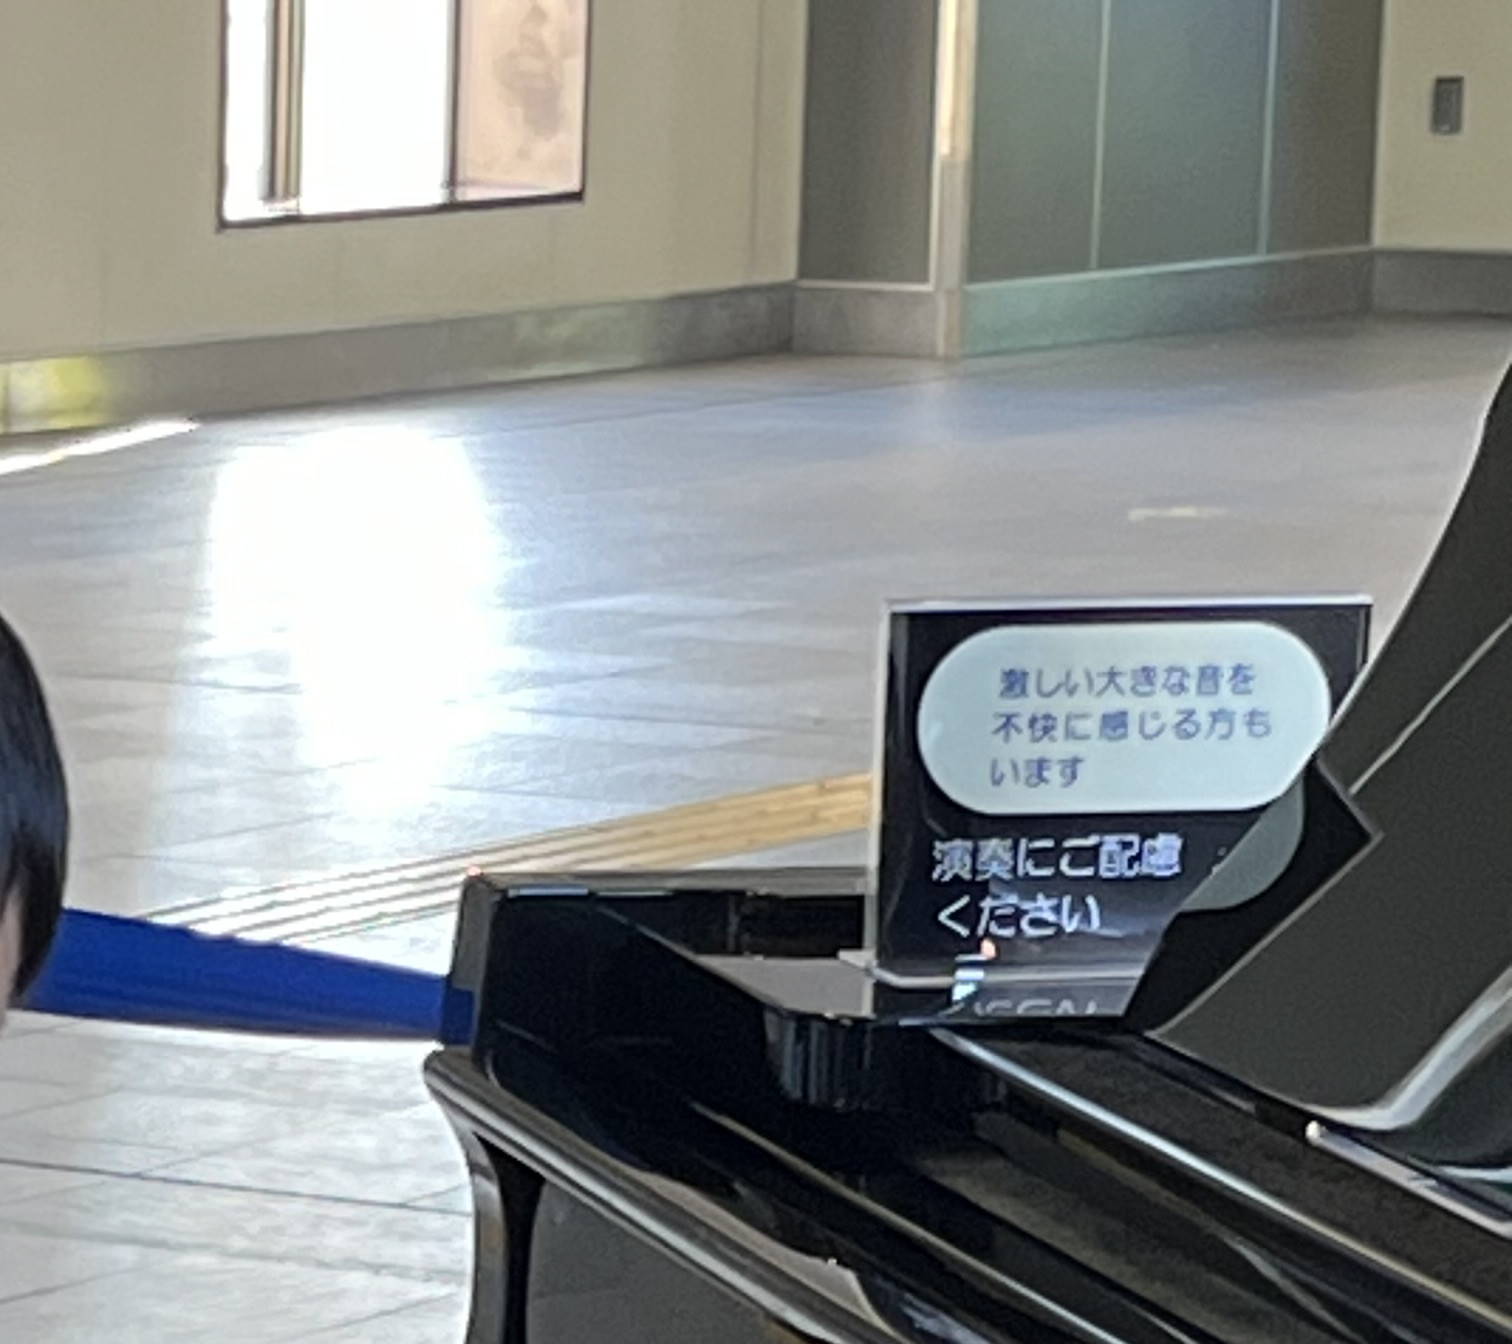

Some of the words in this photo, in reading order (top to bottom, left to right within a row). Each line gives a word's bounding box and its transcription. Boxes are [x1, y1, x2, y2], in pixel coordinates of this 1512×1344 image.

[992, 708, 1272, 743] 不快に感じる方も
[990, 756, 1085, 788] います
[931, 833, 1183, 882] 演奏にご配慮
[938, 892, 1101, 938] ください
